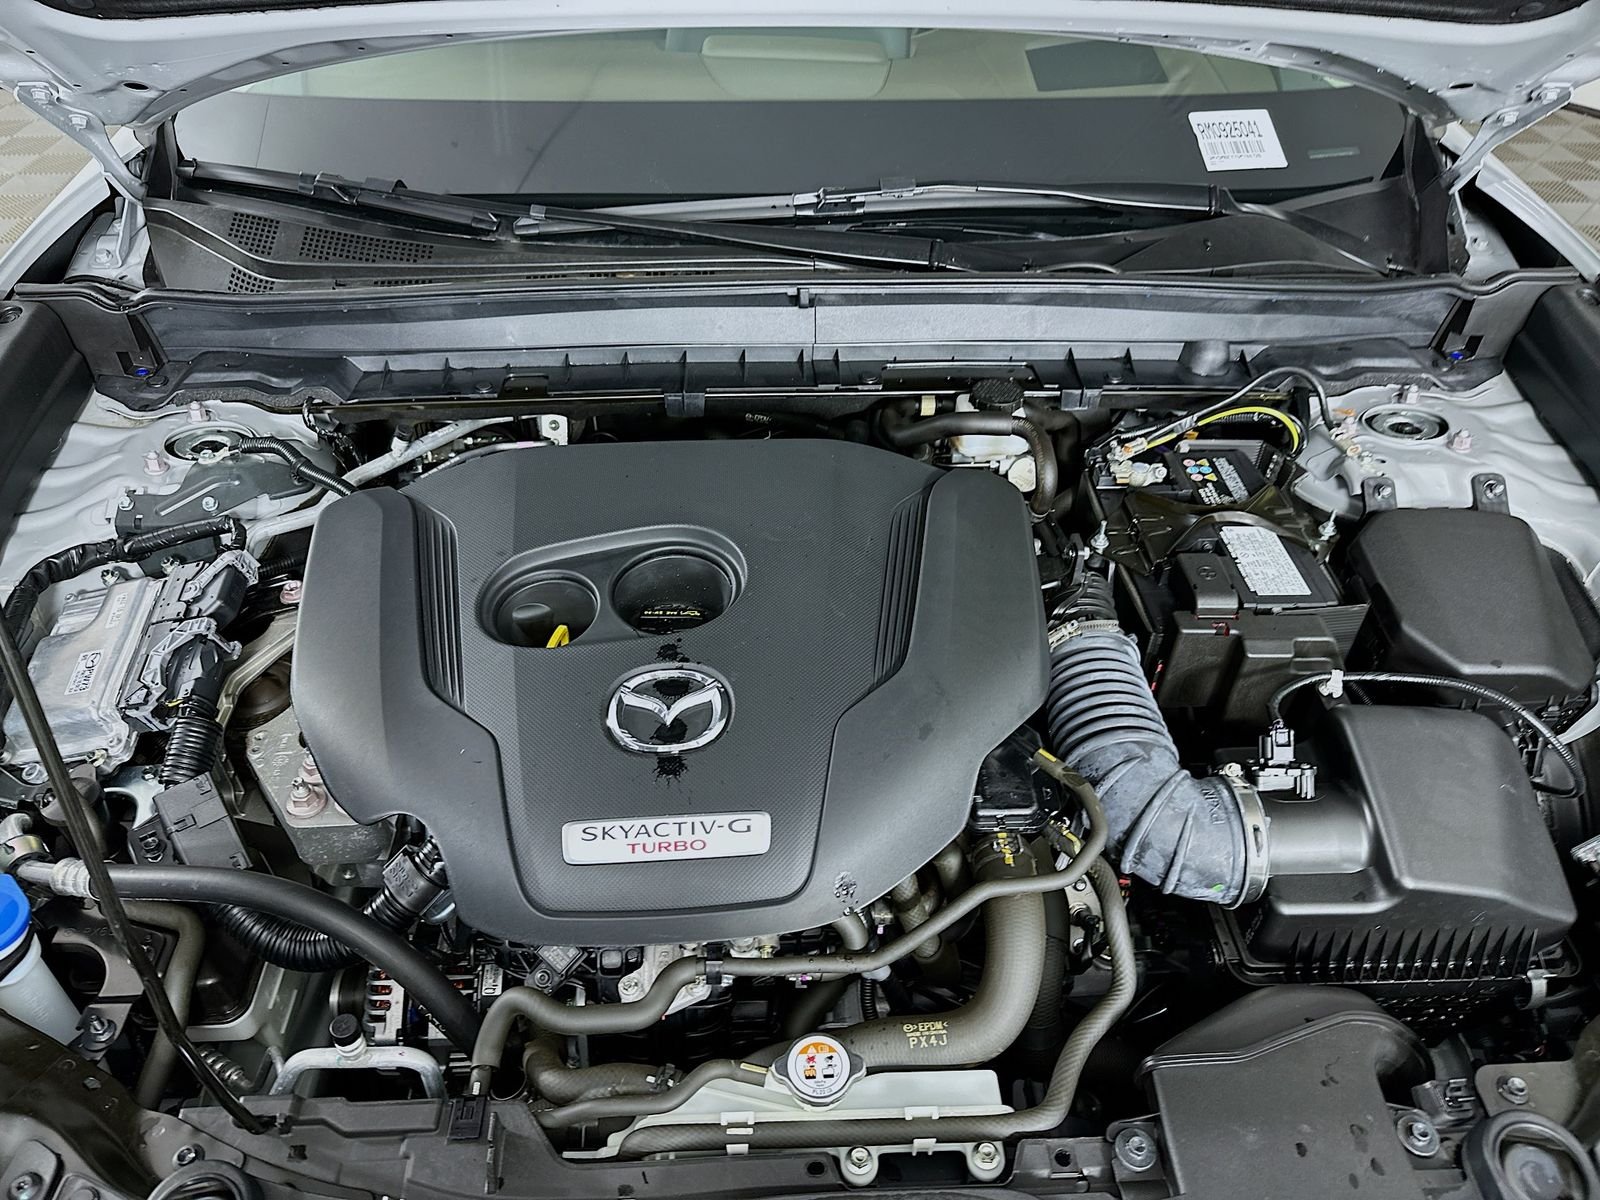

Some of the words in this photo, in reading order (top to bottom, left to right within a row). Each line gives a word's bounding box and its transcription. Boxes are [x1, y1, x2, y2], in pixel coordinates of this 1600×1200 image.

[1197, 120, 1263, 140] RM0925041
[580, 818, 753, 842] SKYACTIV-G
[626, 839, 707, 854] TURBO
[909, 1034, 948, 1049] PX4J
